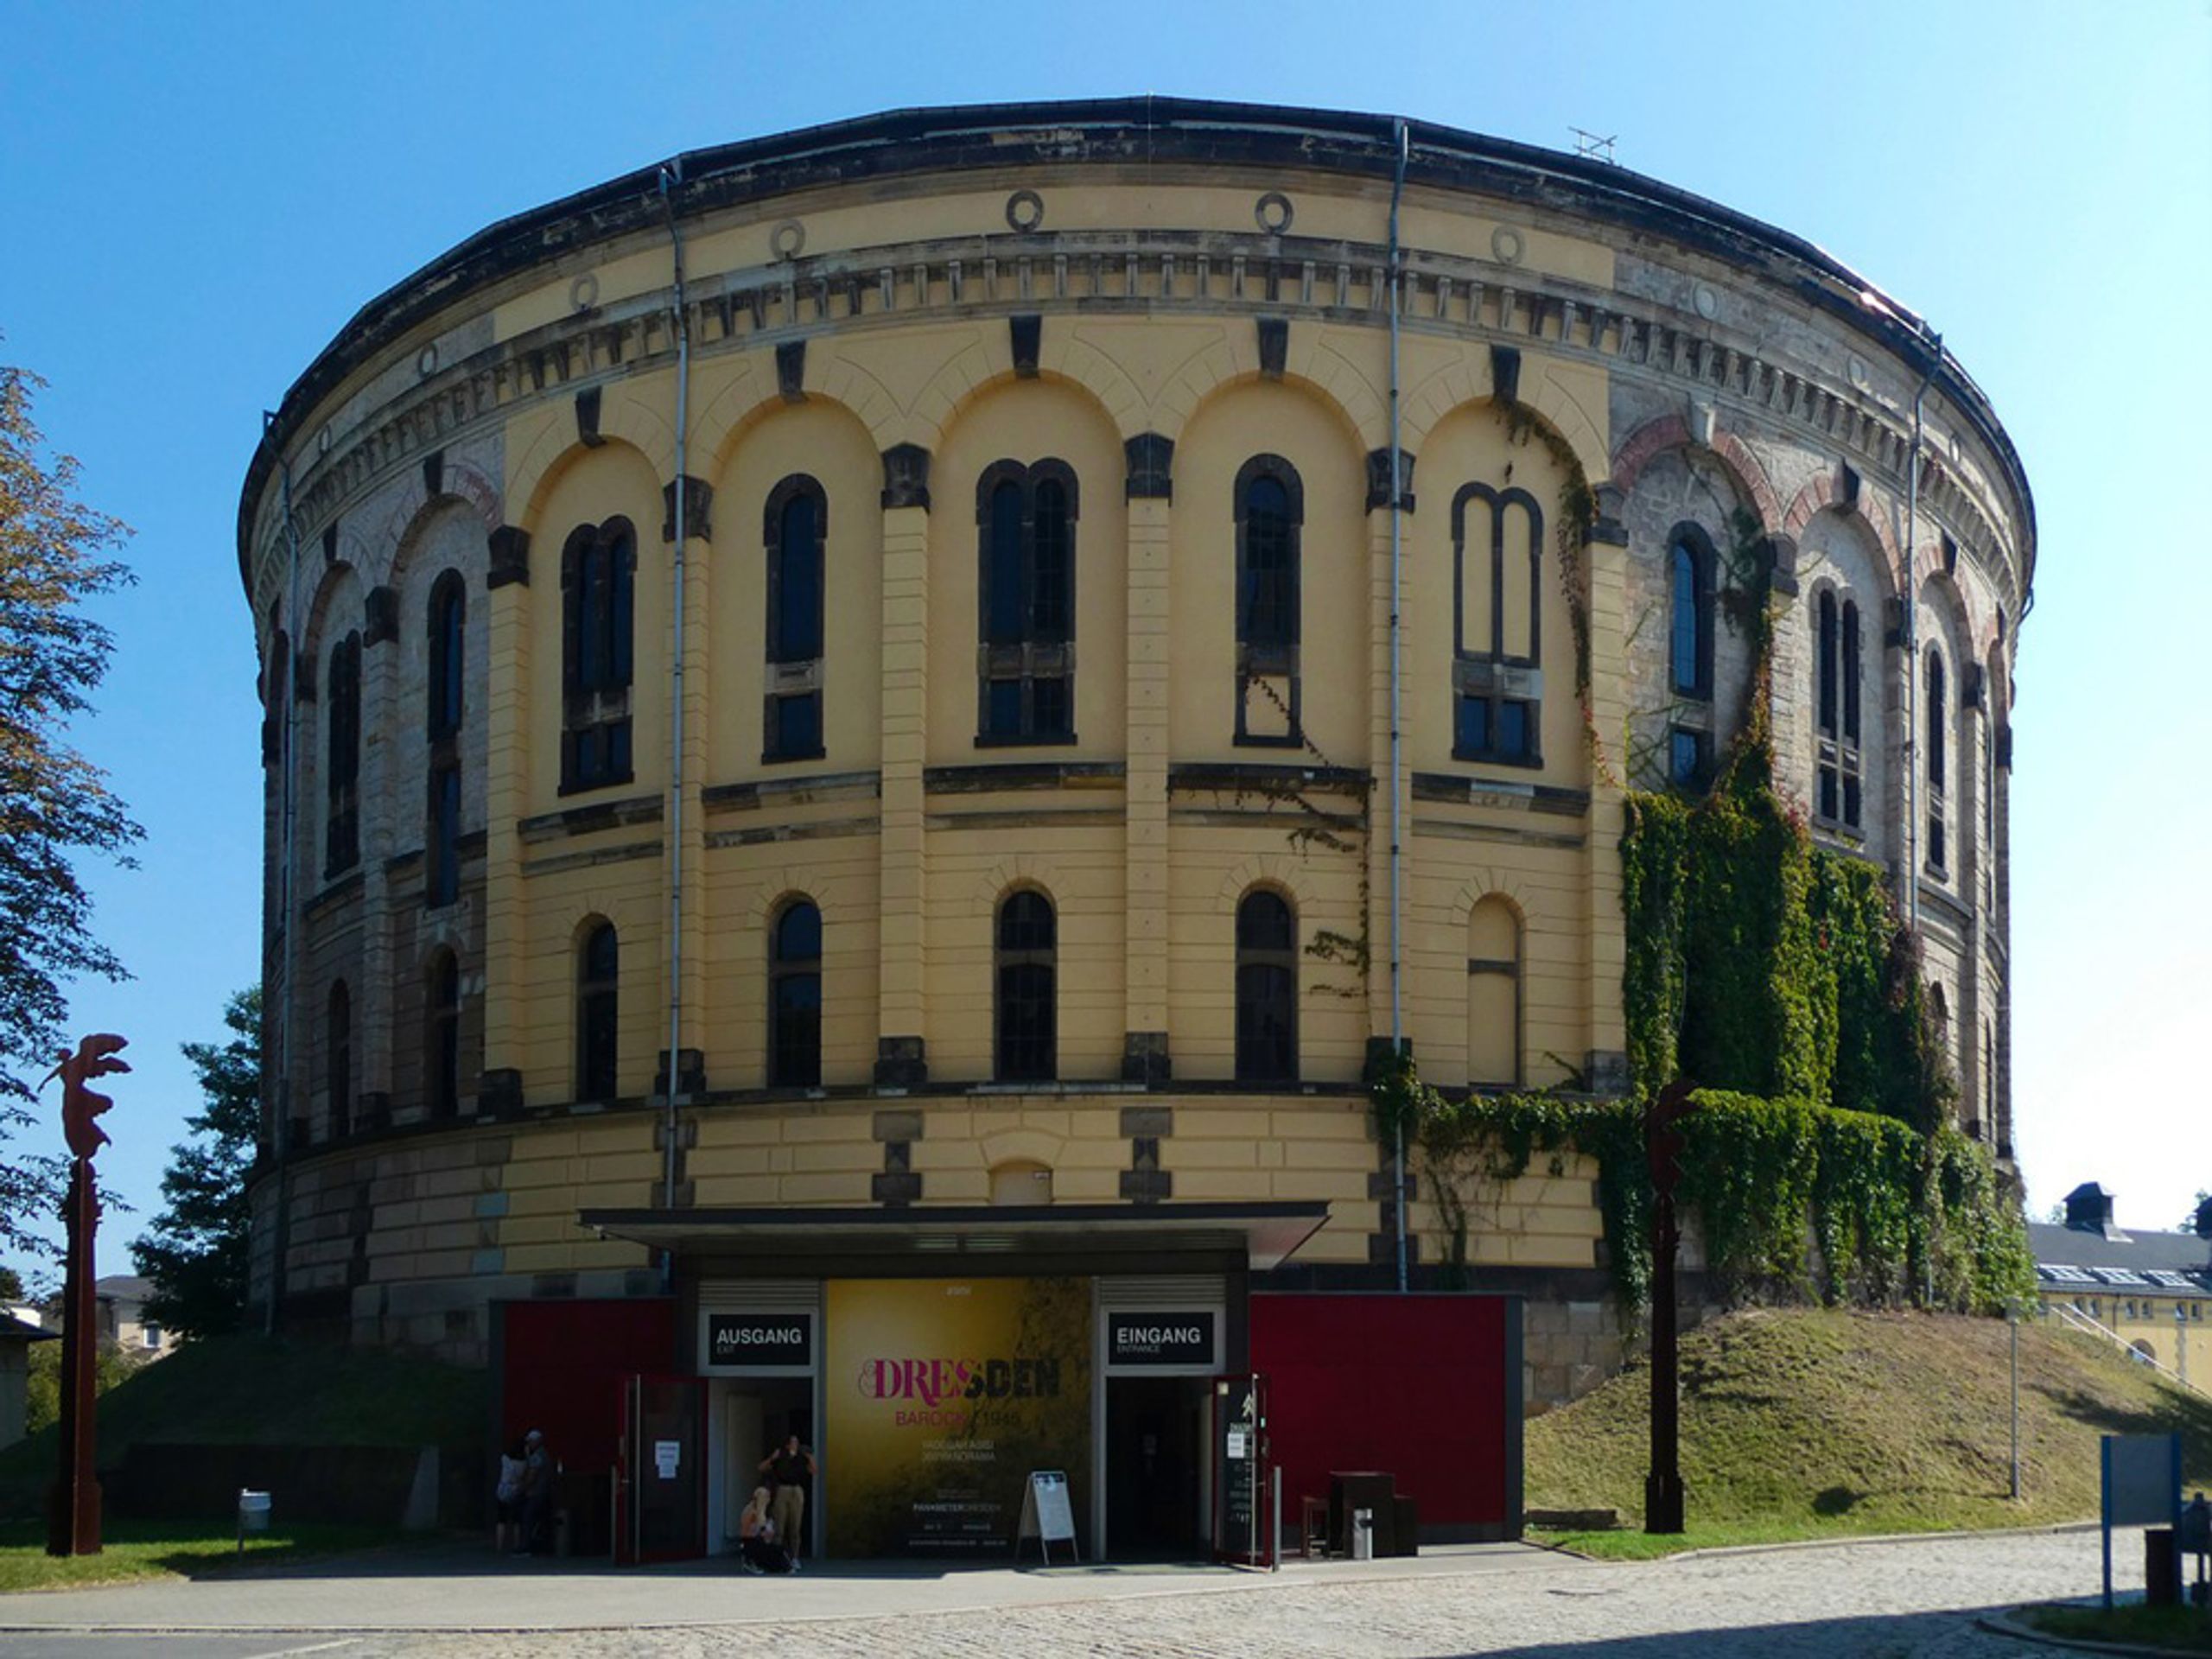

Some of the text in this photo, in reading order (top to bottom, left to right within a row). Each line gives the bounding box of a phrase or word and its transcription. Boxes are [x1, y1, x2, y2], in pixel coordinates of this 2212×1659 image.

[716, 1327, 803, 1344] AUSGANG
[1116, 1326, 1202, 1344] EINGANG
[1116, 1344, 1161, 1354] ENTRANCE
[858, 1358, 1059, 1408] DRESDEN
